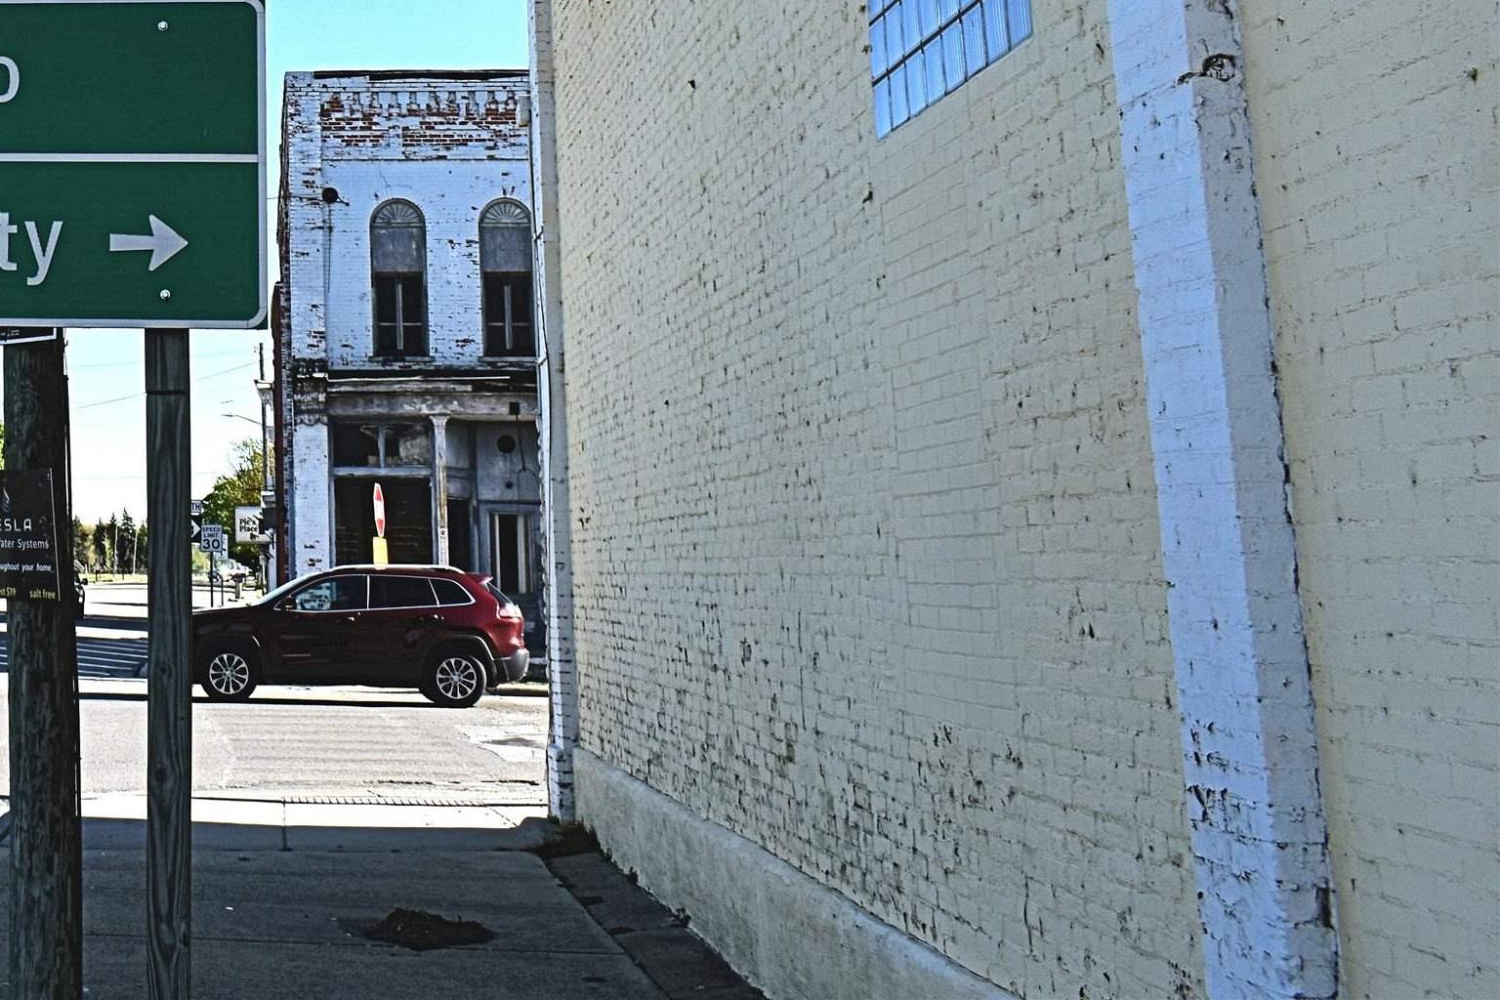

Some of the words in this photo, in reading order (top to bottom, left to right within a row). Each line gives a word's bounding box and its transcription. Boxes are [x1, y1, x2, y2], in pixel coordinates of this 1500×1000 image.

[239, 525, 258, 533] Place
[17, 539, 50, 552] Systems
[202, 538, 220, 550] 30
[21, 564, 35, 574] your
[29, 589, 42, 599] salt
[43, 589, 56, 600] free
